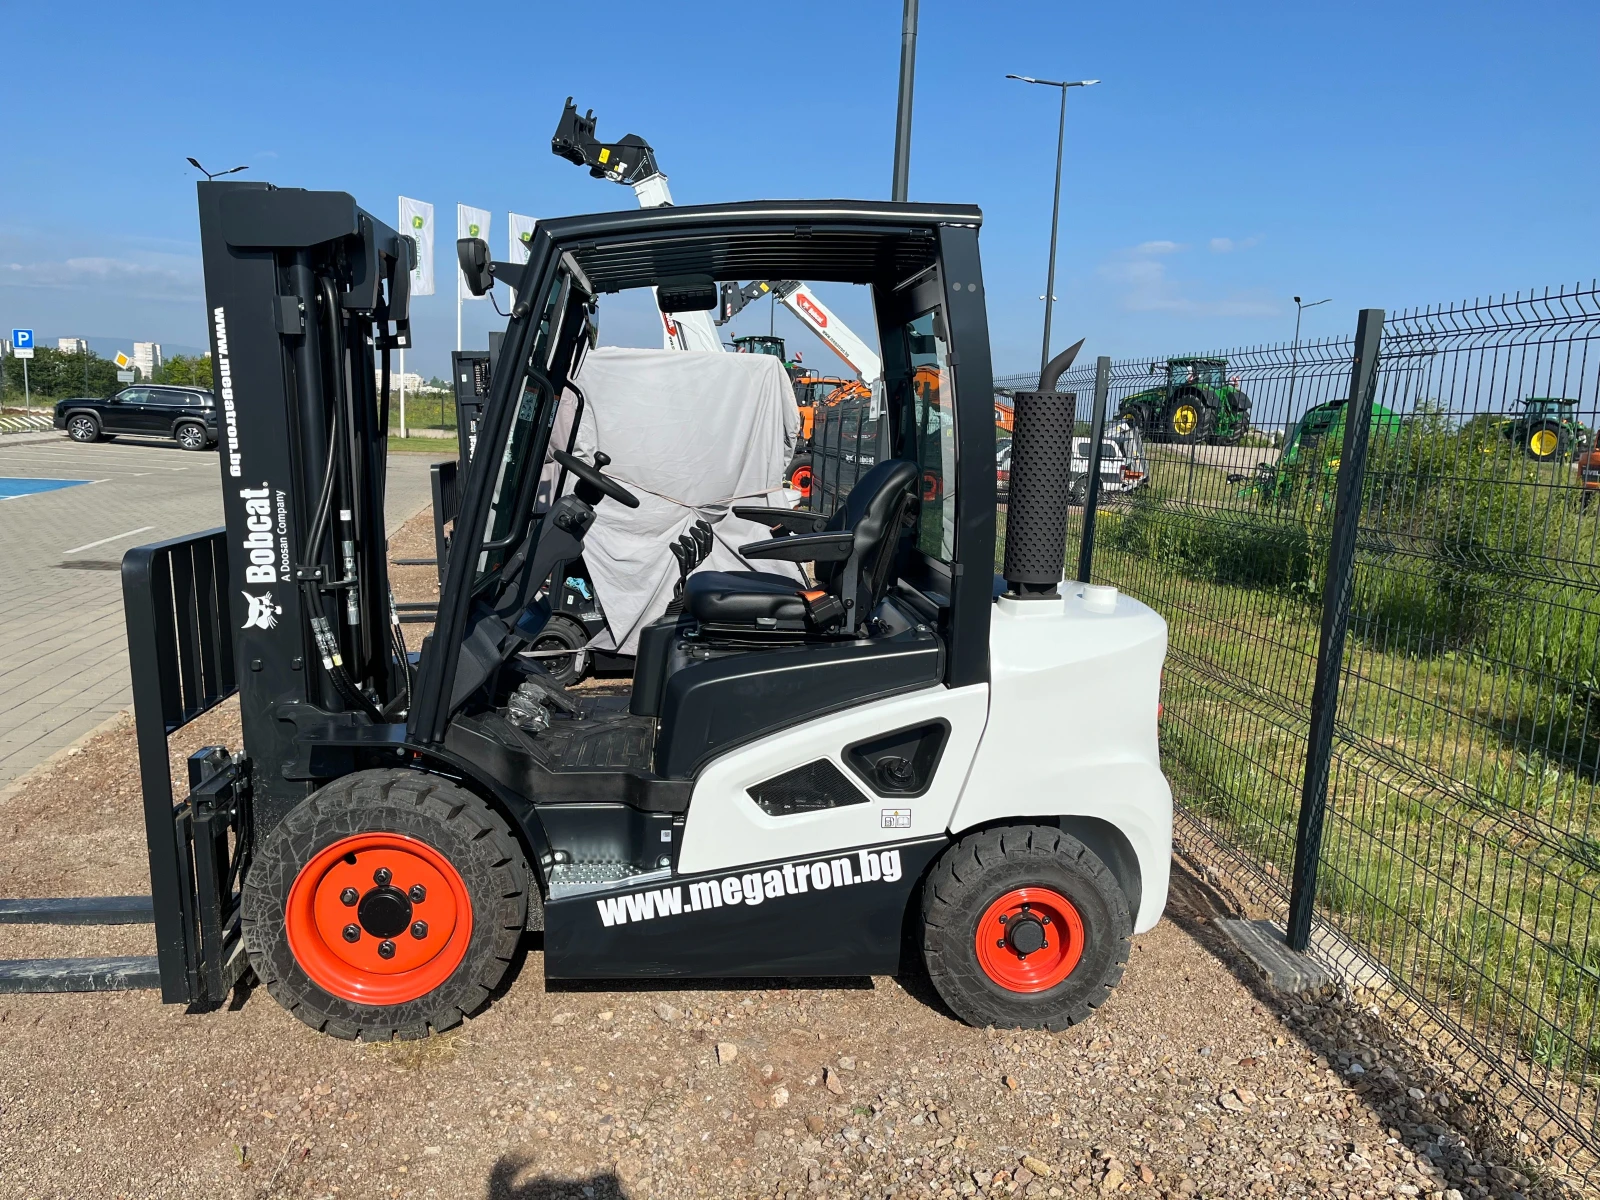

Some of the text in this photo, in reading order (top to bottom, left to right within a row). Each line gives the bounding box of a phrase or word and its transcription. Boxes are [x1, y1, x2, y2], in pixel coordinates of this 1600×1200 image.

[18, 331, 29, 346] P
[214, 307, 241, 477] www.megatron.bg
[276, 490, 291, 582] A Doosan Company
[597, 850, 902, 927] www.megatron.bg
